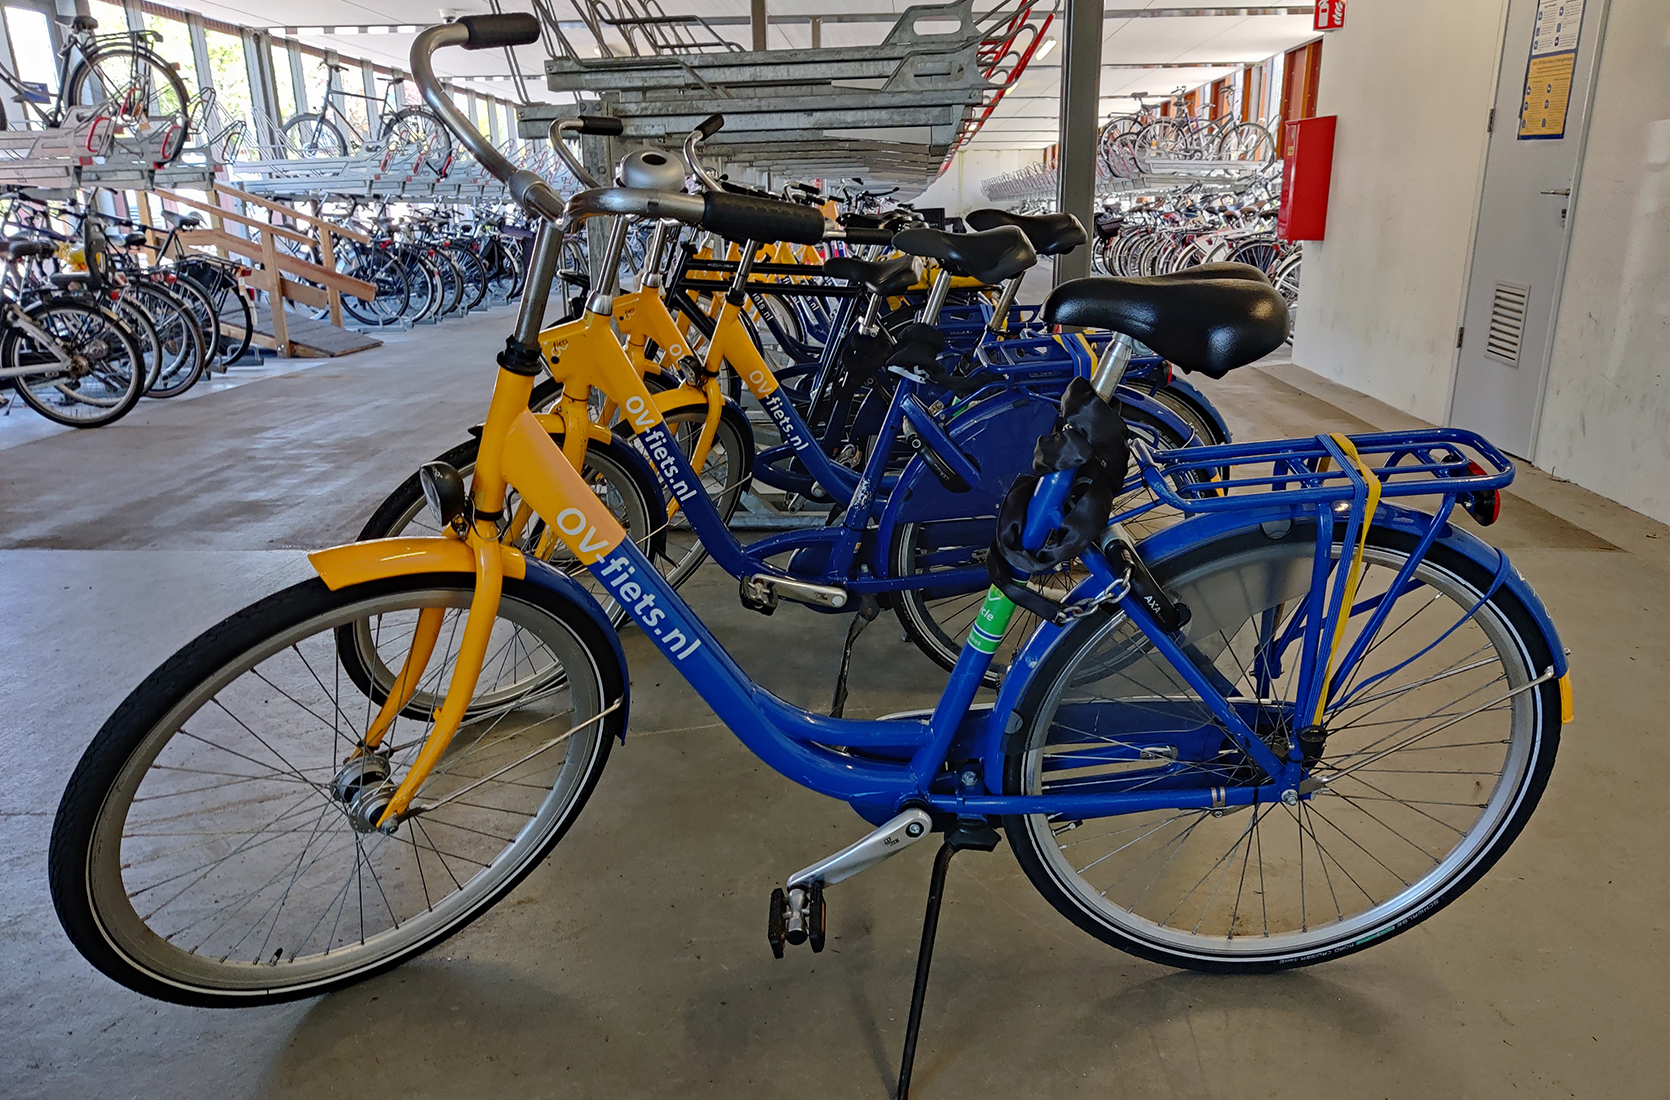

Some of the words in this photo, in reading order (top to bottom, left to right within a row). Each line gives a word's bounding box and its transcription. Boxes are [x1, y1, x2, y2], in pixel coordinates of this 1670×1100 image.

[625, 396, 698, 502] OV-fiets.nl
[749, 370, 810, 451] OV-fiets.nl
[556, 507, 702, 661] OV-fiets.nl
[1143, 595, 1161, 614] AXA
